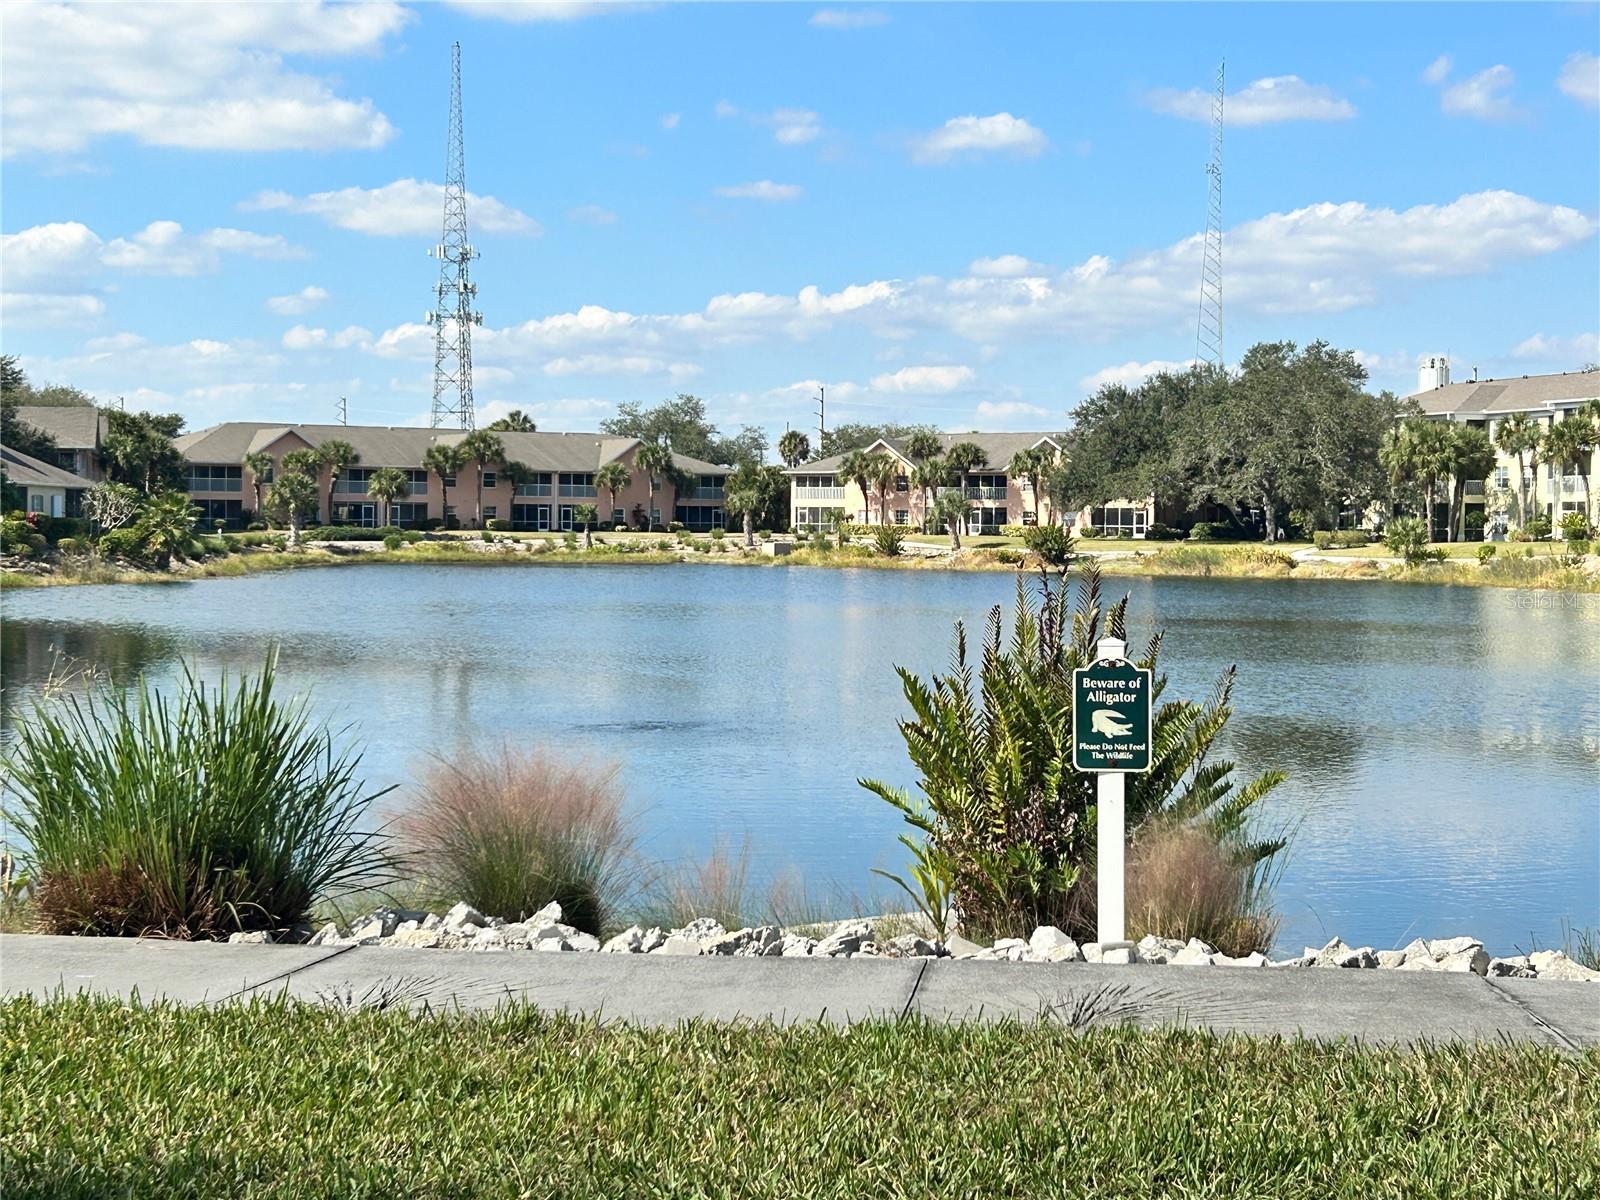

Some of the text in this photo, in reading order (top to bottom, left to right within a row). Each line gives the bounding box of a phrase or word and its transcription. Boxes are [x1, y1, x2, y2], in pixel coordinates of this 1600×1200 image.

[1082, 677, 1141, 688] Beware of
[1086, 690, 1137, 705] Alligator
[1079, 742, 1146, 751] Please Do Not Feed
[1106, 751, 1133, 759] Wildlife
